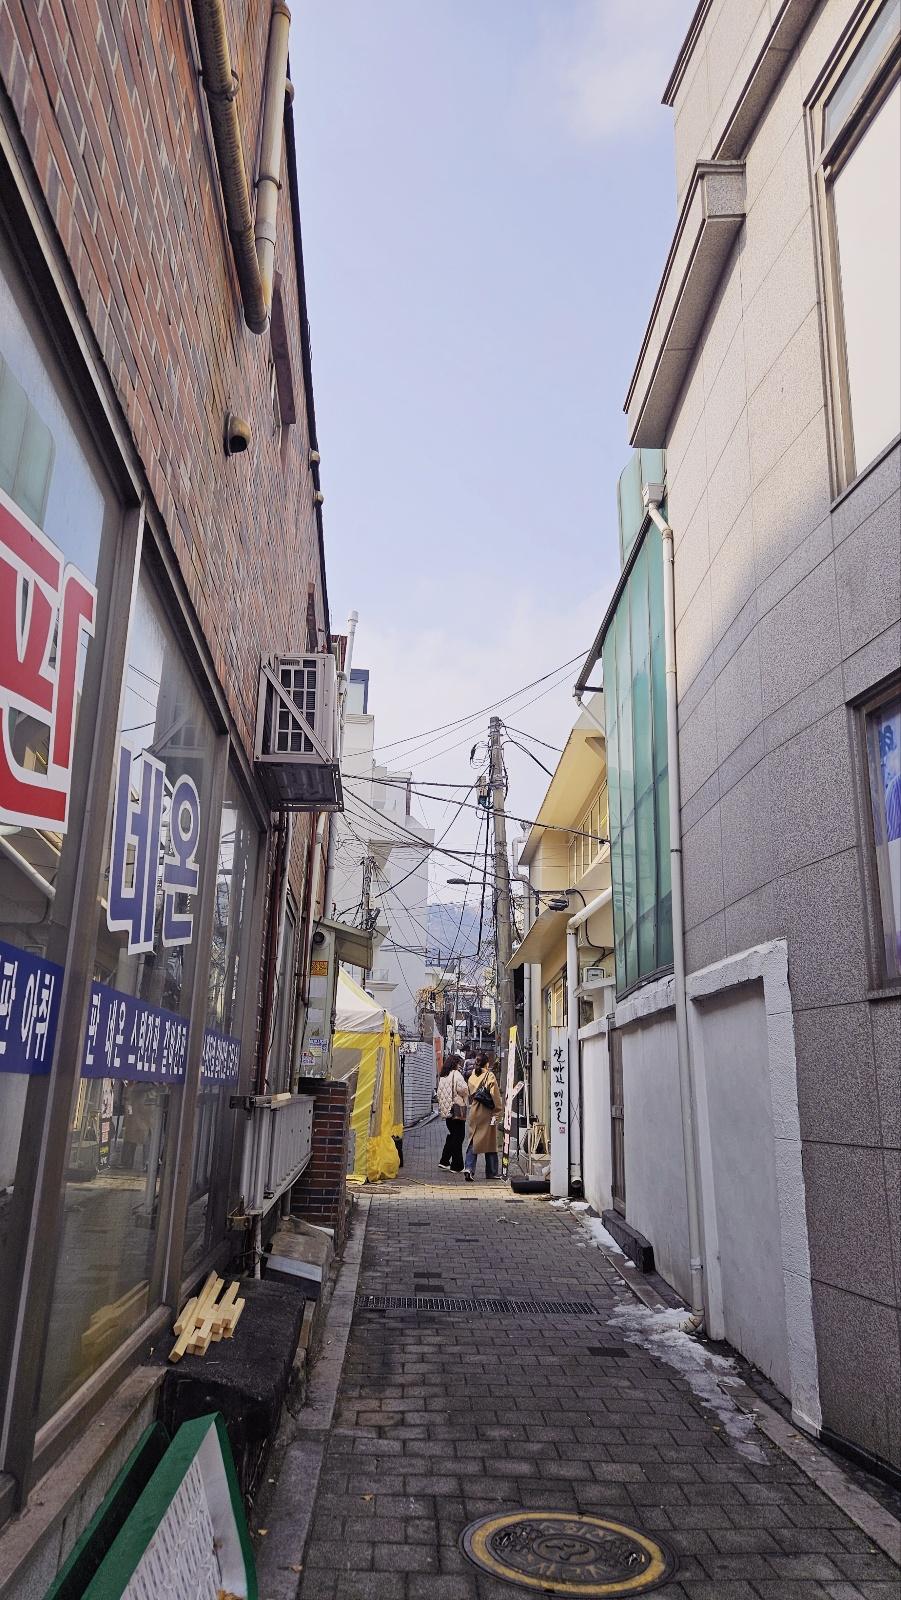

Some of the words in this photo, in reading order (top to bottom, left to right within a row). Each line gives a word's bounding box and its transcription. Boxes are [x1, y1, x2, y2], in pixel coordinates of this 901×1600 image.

[107, 743, 200, 955] 네온
[21, 969, 55, 1062] 아취
[86, 993, 101, 1065] 판
[105, 999, 126, 1068] 네온
[128, 1009, 161, 1072] 스텐간판
[553, 1046, 566, 1084] 잘빠진
[553, 1089, 567, 1124] 메밀
